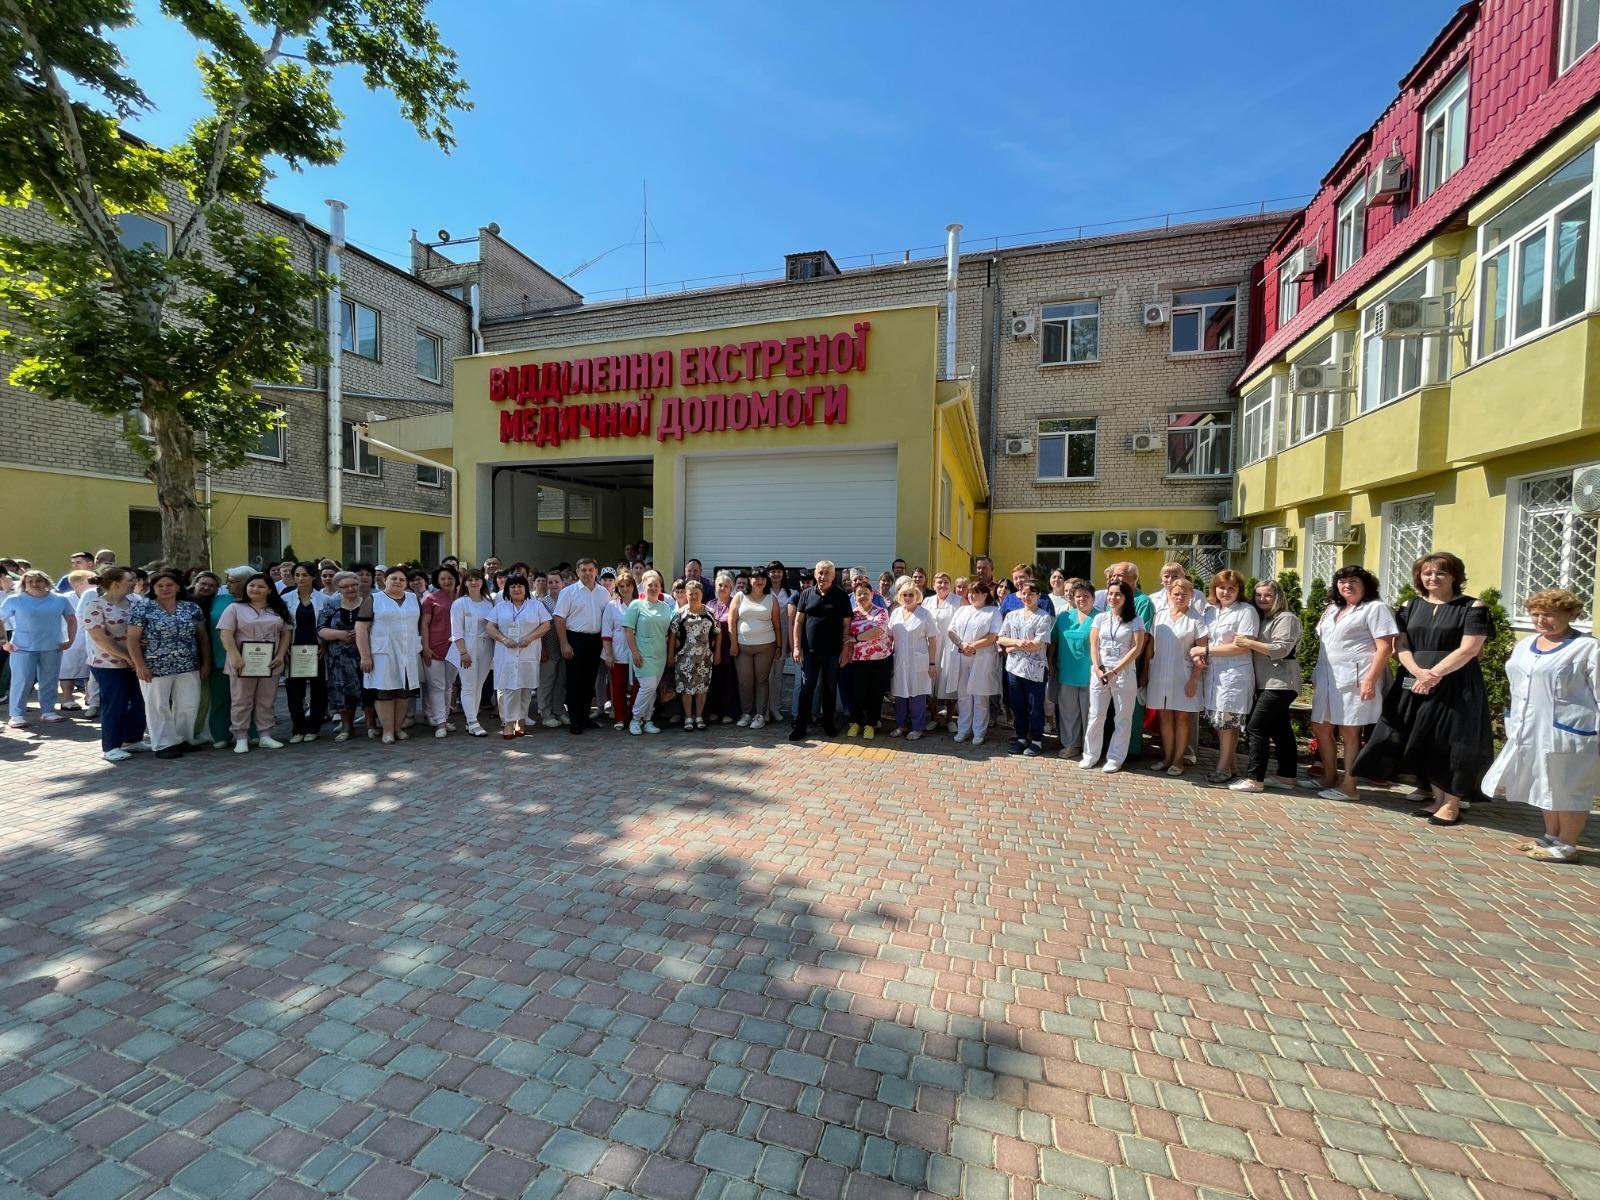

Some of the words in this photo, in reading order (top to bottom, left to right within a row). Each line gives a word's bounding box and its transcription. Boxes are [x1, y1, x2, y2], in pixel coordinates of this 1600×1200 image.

[490, 350, 673, 406] ВІДДІЛЕННЯ
[680, 321, 871, 386] ЕКСТРЕНОЇ
[500, 393, 654, 448] МЕДИЧНОЇ
[656, 383, 848, 442] ДОПОМОГИ
